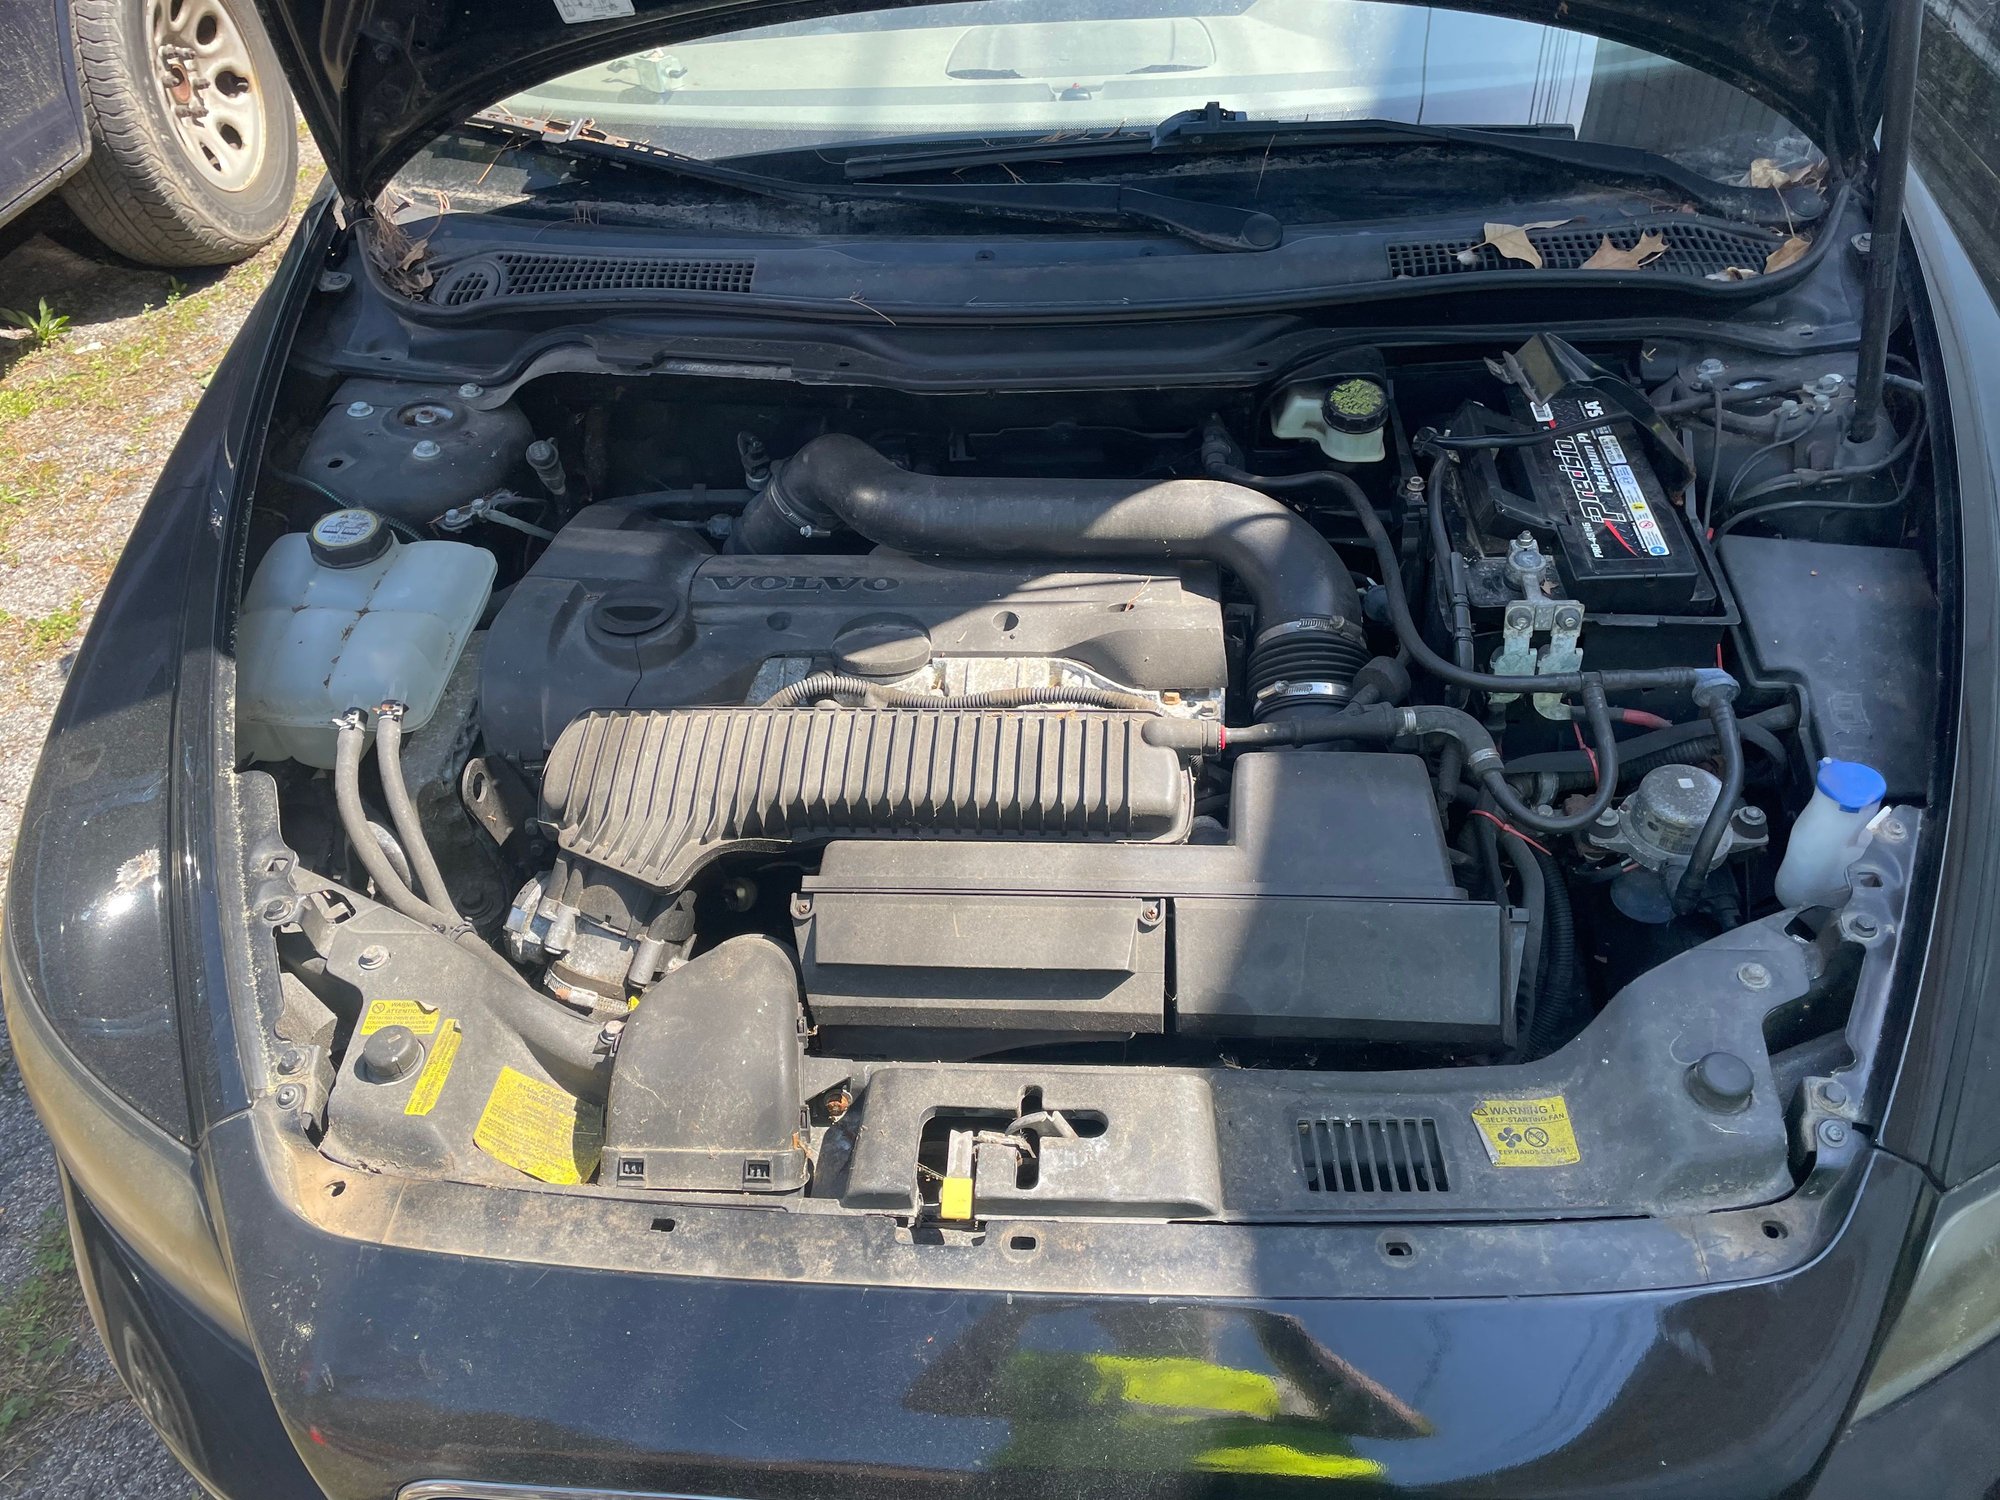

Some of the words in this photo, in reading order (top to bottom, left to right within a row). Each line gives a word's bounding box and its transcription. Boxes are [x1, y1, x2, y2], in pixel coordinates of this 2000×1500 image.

[1584, 445, 1614, 493] Platinum
[1553, 436, 1628, 523] Precisio
[705, 576, 901, 592] VOLVO
[1489, 1105, 1548, 1115] WARNING
[1548, 1113, 1565, 1121] FAN
